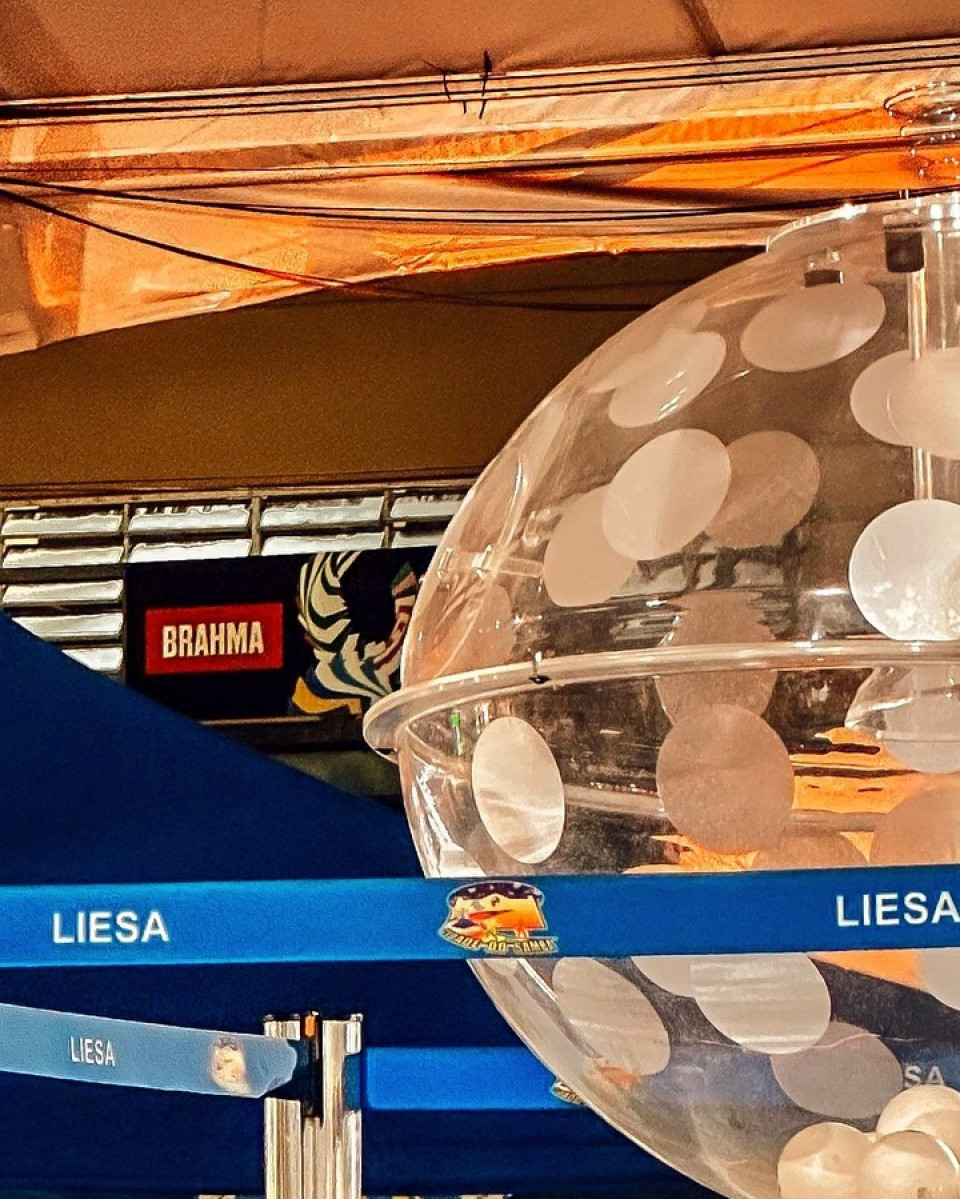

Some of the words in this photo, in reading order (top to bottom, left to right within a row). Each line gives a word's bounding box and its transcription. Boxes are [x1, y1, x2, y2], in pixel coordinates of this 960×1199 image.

[162, 621, 265, 659] BRAHMA
[52, 911, 169, 944] LIESA
[70, 1035, 116, 1067] LIESA
